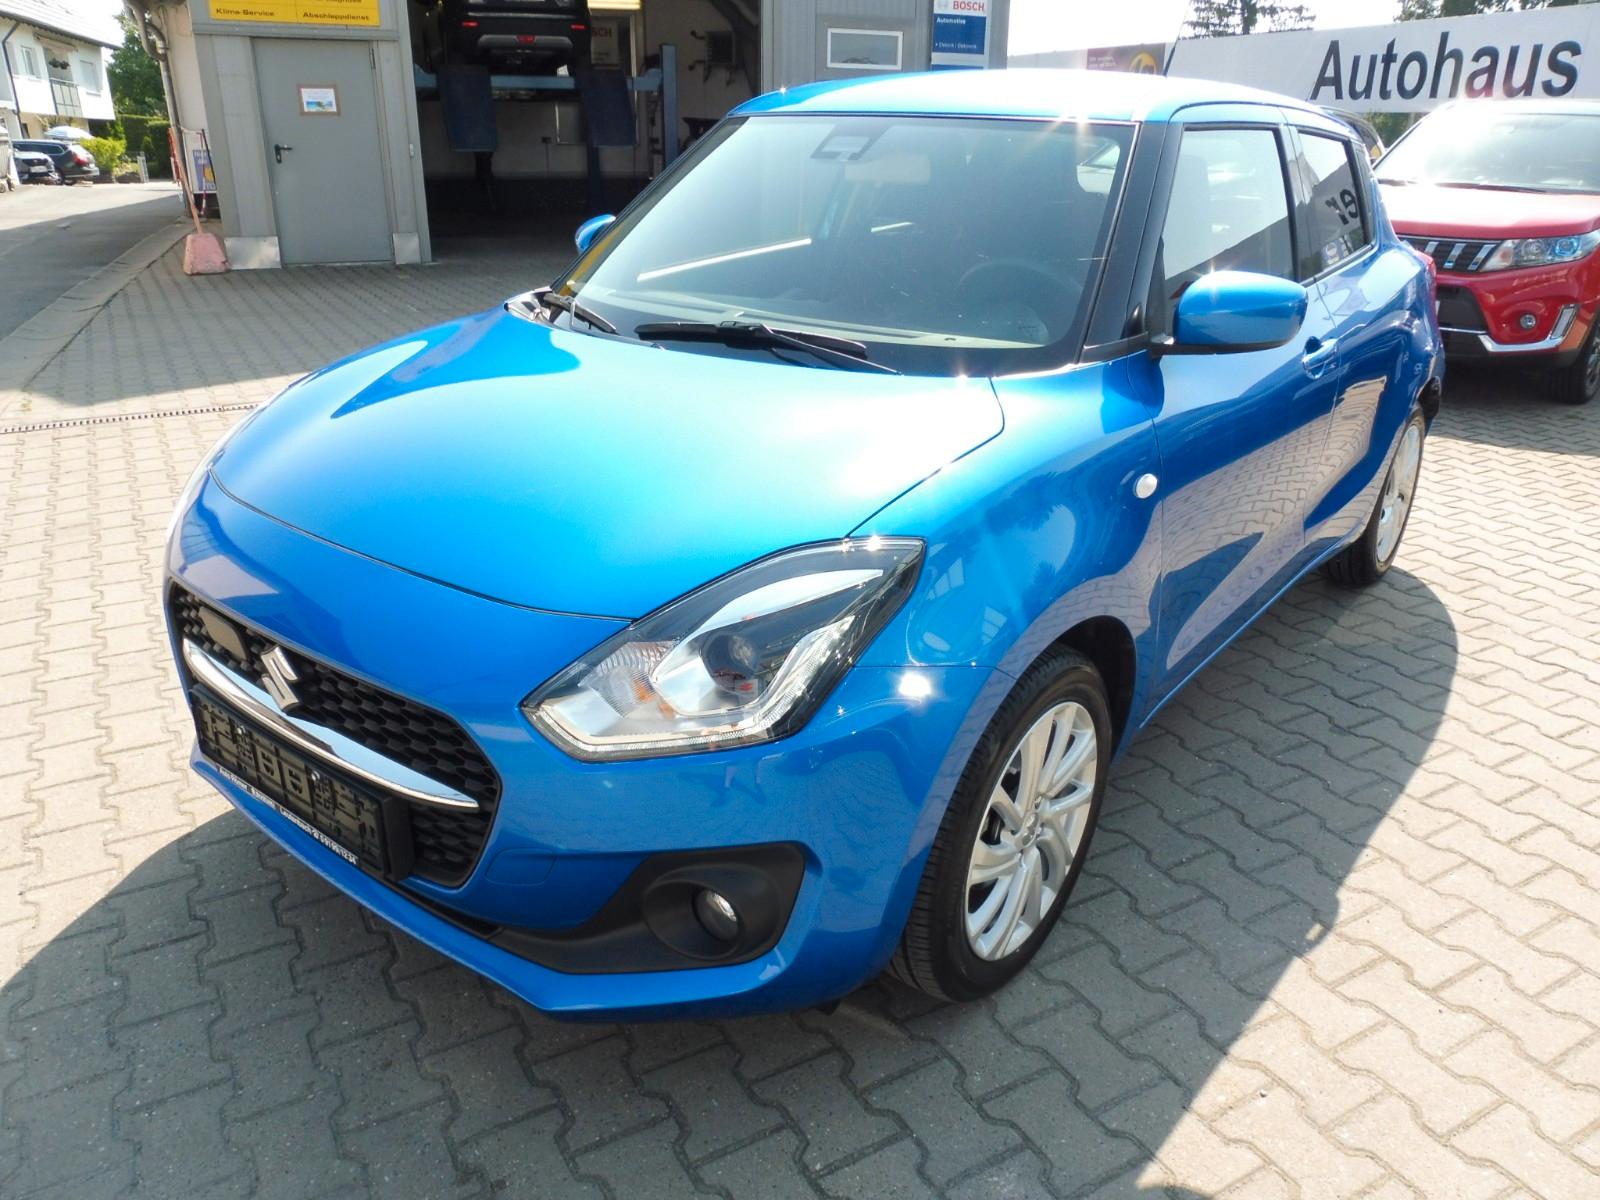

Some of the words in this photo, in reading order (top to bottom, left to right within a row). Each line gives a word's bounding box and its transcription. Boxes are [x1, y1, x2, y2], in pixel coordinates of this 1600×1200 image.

[953, 1, 984, 11] BOSCH
[303, 12, 369, 21] Abschleppdienst
[1309, 31, 1582, 101] Autohaus
